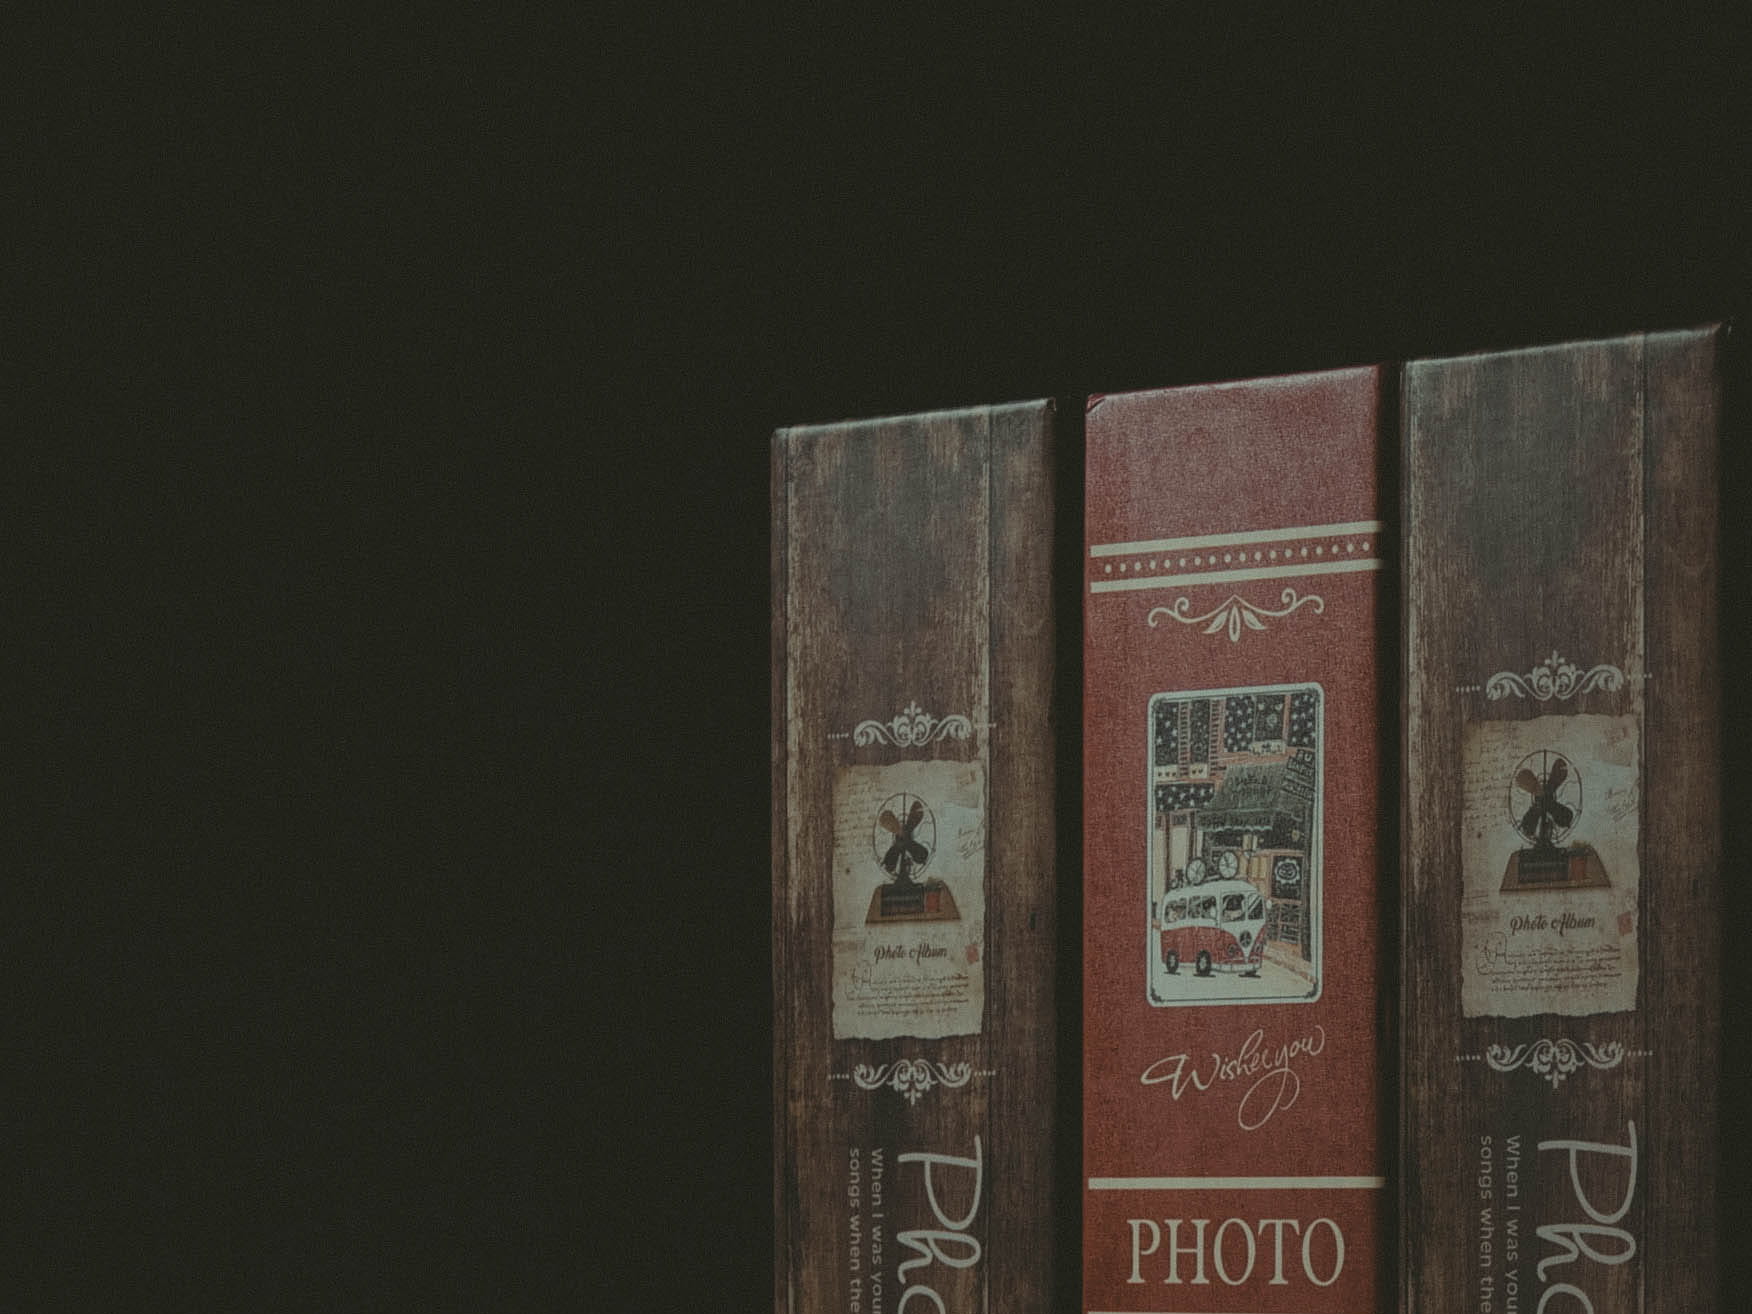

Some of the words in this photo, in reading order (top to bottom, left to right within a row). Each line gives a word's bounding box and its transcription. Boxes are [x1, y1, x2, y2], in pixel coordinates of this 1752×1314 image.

[1510, 914, 1549, 935] Photo
[1551, 912, 1596, 937] Album
[1238, 1025, 1325, 1130] you
[848, 1148, 859, 1208] songs
[870, 1148, 883, 1206] When
[1478, 1135, 1492, 1200] songs
[1505, 1135, 1521, 1198] When
[849, 1215, 862, 1271] when
[871, 1225, 882, 1265] was
[1126, 1217, 1345, 1287] PHOTO
[1479, 1207, 1494, 1267] when
[1506, 1219, 1518, 1262] was
